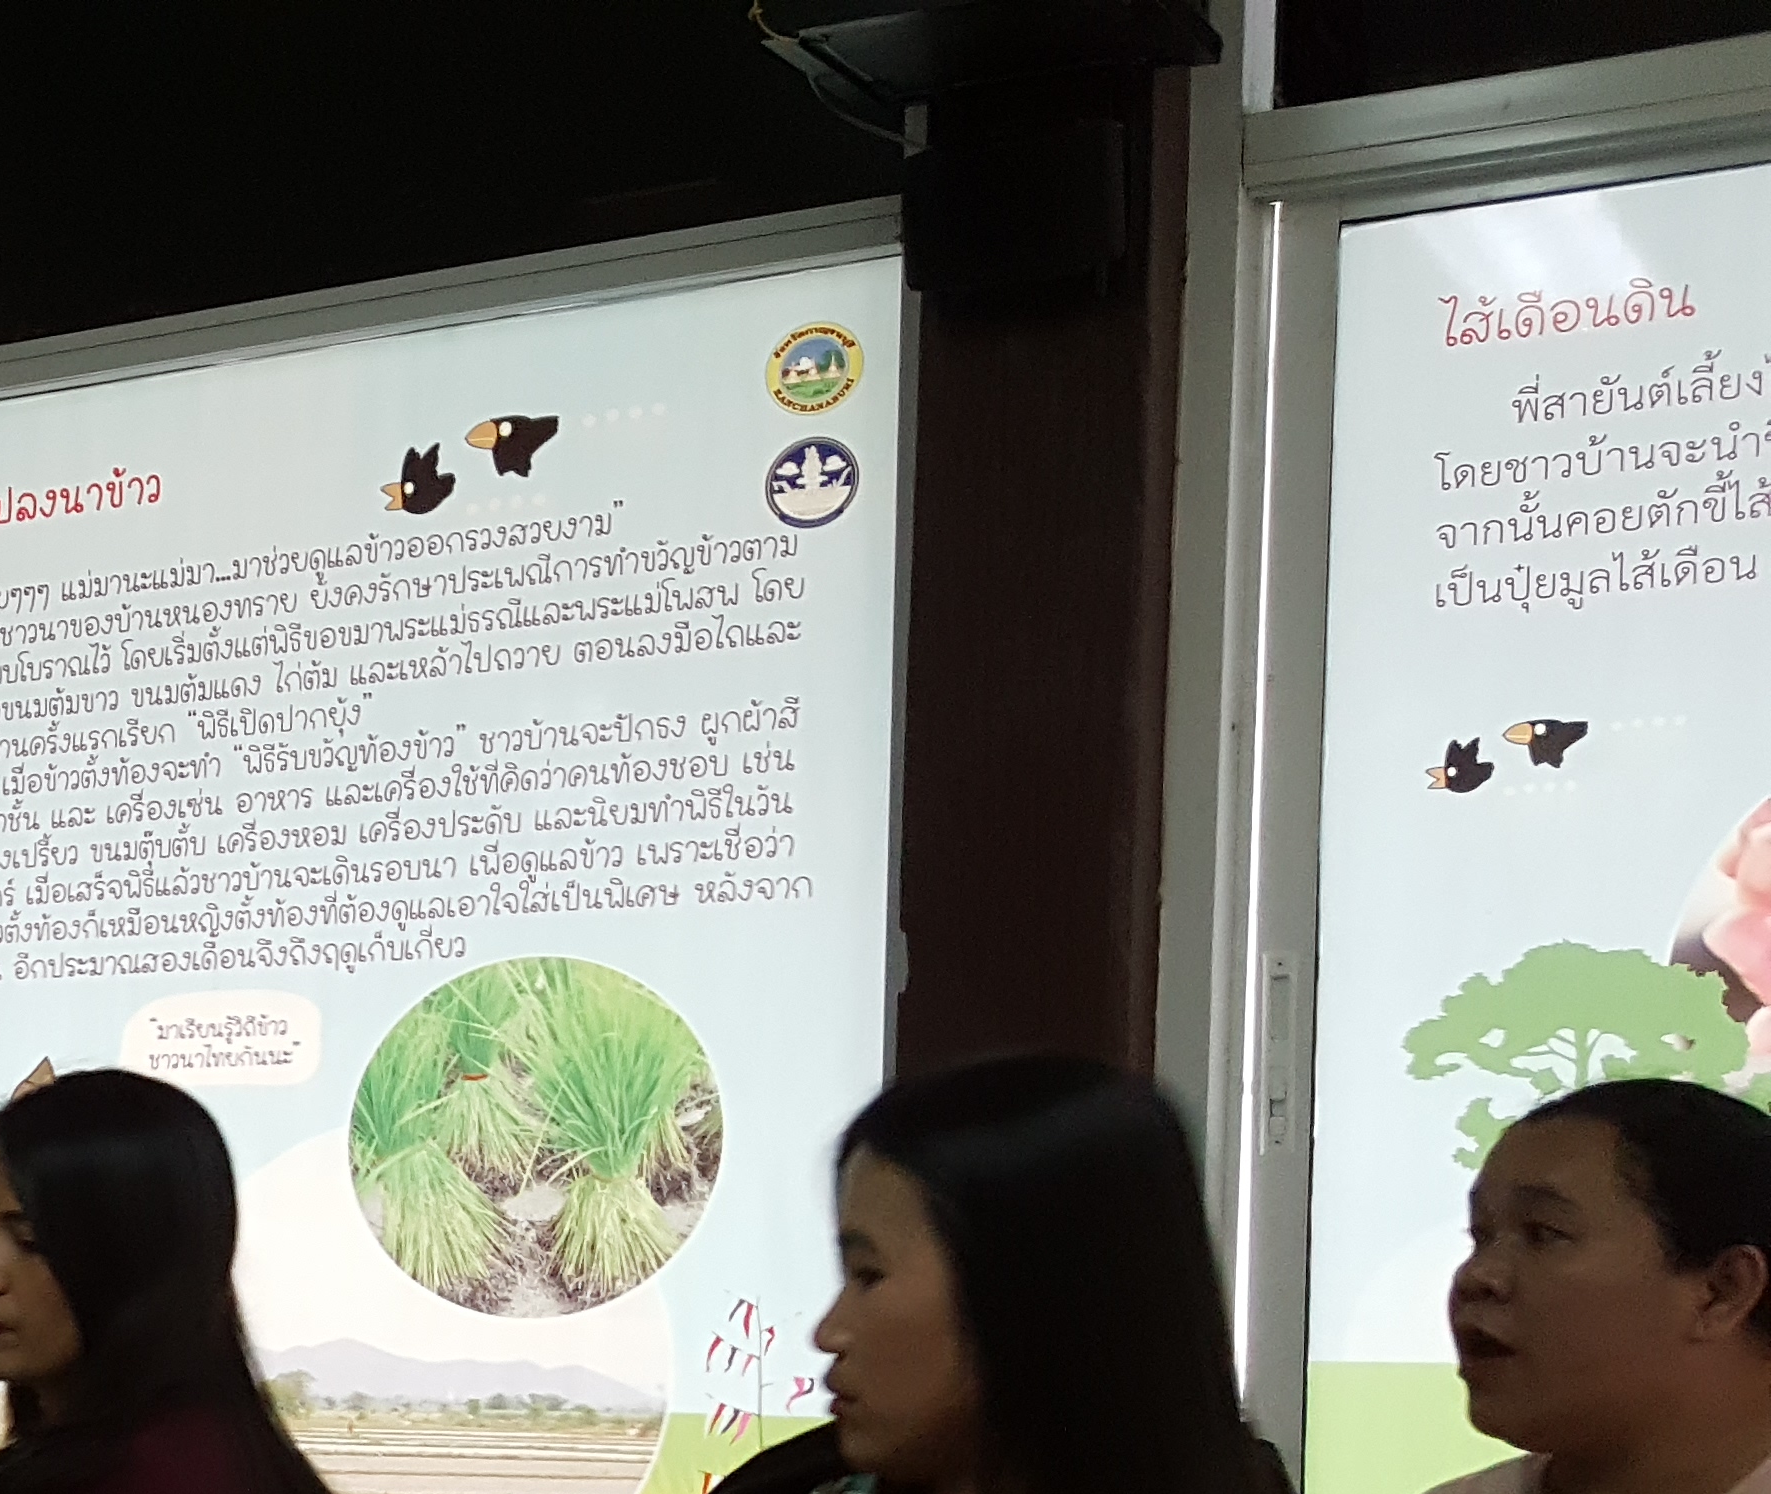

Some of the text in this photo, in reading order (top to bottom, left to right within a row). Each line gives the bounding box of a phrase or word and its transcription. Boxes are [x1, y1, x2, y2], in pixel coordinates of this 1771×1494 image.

[1437, 277, 1697, 347] ไส้เดือนดิน
[1511, 349, 1771, 424] พี่สายันต์เลี้ยง
[751, 566, 805, 603] โดย
[1435, 544, 1758, 614] เป็นปุ๋ยมูลไส้เดือน
[130, 672, 262, 708] ขนมต้มแดง
[271, 659, 338, 694] ไก่ต้ม
[350, 640, 561, 686] และเหล้าไปถวาย
[573, 613, 802, 664] ตอนลงมือไถและ
[2, 751, 221, 796] เมื่อข้าวตั้งท้องจะทำ
[479, 713, 686, 755] ชาวบ้านจะปักธง
[701, 696, 801, 747] ผูกผ้าสี
[51, 806, 96, 829] และ
[106, 787, 223, 825] เครื่องเซ่น
[235, 787, 314, 814] อาหาร
[743, 740, 795, 775] เช่น
[89, 822, 206, 863] ขนมตุ๊บตั้บ
[217, 817, 347, 854] เครื่องหอม
[359, 804, 522, 844] เครื่องประดับ
[534, 783, 794, 832] และนิยมทำพิธีในวัน
[469, 837, 623, 884] เพื่อดูแลข้าว
[637, 822, 795, 866] เพราะเชื่อว่า
[694, 870, 812, 904] หลังจาก
